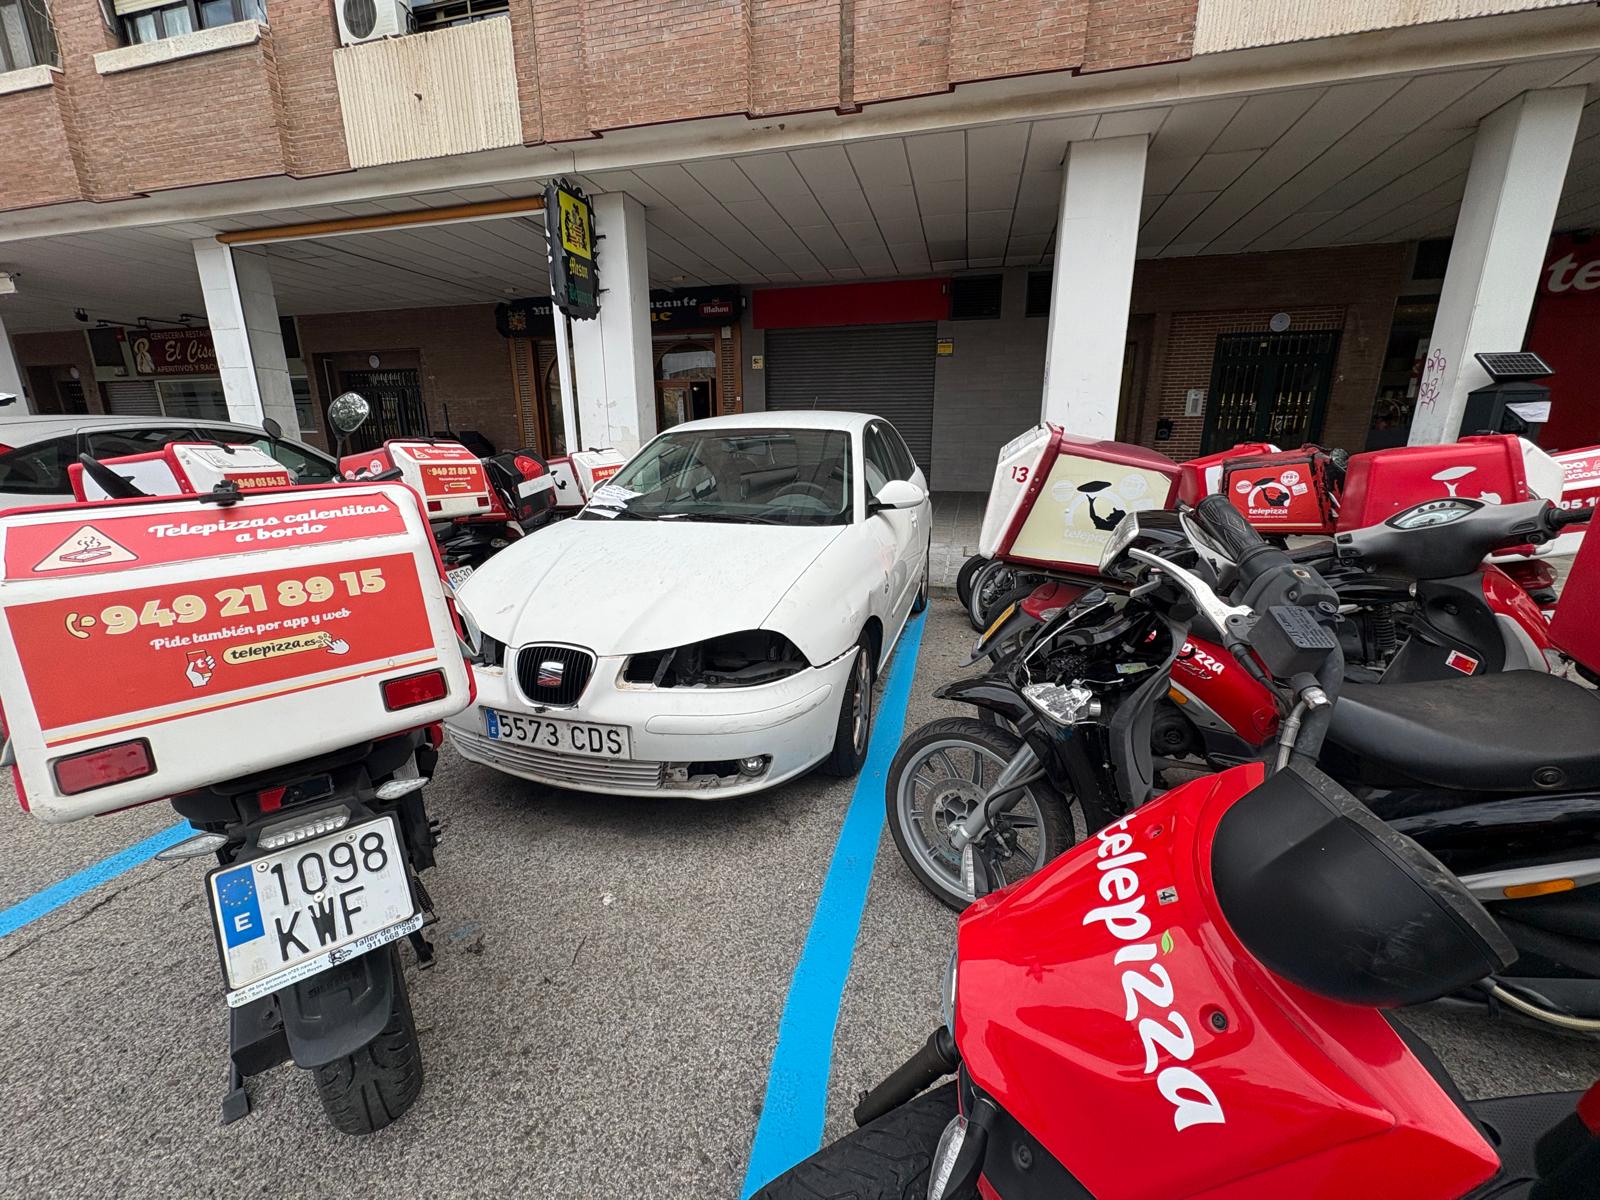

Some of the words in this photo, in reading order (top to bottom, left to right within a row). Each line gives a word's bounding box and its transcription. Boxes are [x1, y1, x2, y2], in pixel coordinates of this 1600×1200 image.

[165, 340, 181, 362] El
[431, 467, 447, 476] 949
[448, 467, 457, 475] 21
[468, 466, 477, 475] 15
[1011, 465, 1029, 483] 13
[148, 515, 281, 538] Telepizzas
[283, 503, 390, 524] calentitas
[1248, 508, 1288, 516] telepizza
[235, 533, 253, 543] a
[257, 523, 327, 540] bordo
[100, 595, 208, 635] 949
[215, 584, 268, 618] 21
[278, 575, 334, 607] 89
[340, 567, 387, 597] 15
[150, 636, 192, 651] Pide
[192, 624, 256, 643] también
[256, 621, 281, 635] por
[283, 616, 309, 630] app
[311, 614, 320, 624] y
[322, 608, 351, 620] web
[230, 638, 316, 660] telepizza.es
[500, 715, 560, 747] 5573
[571, 726, 622, 755] CDS
[271, 832, 388, 906] 1098
[233, 911, 253, 933] E
[275, 885, 364, 961] KWF
[355, 934, 378, 948] Taller
[380, 928, 391, 937] de
[393, 916, 420, 931] motos
[366, 939, 382, 950] 911
[384, 931, 400, 942] 668
[401, 924, 417, 934] 298
[1082, 813, 1226, 1132] telepizza
